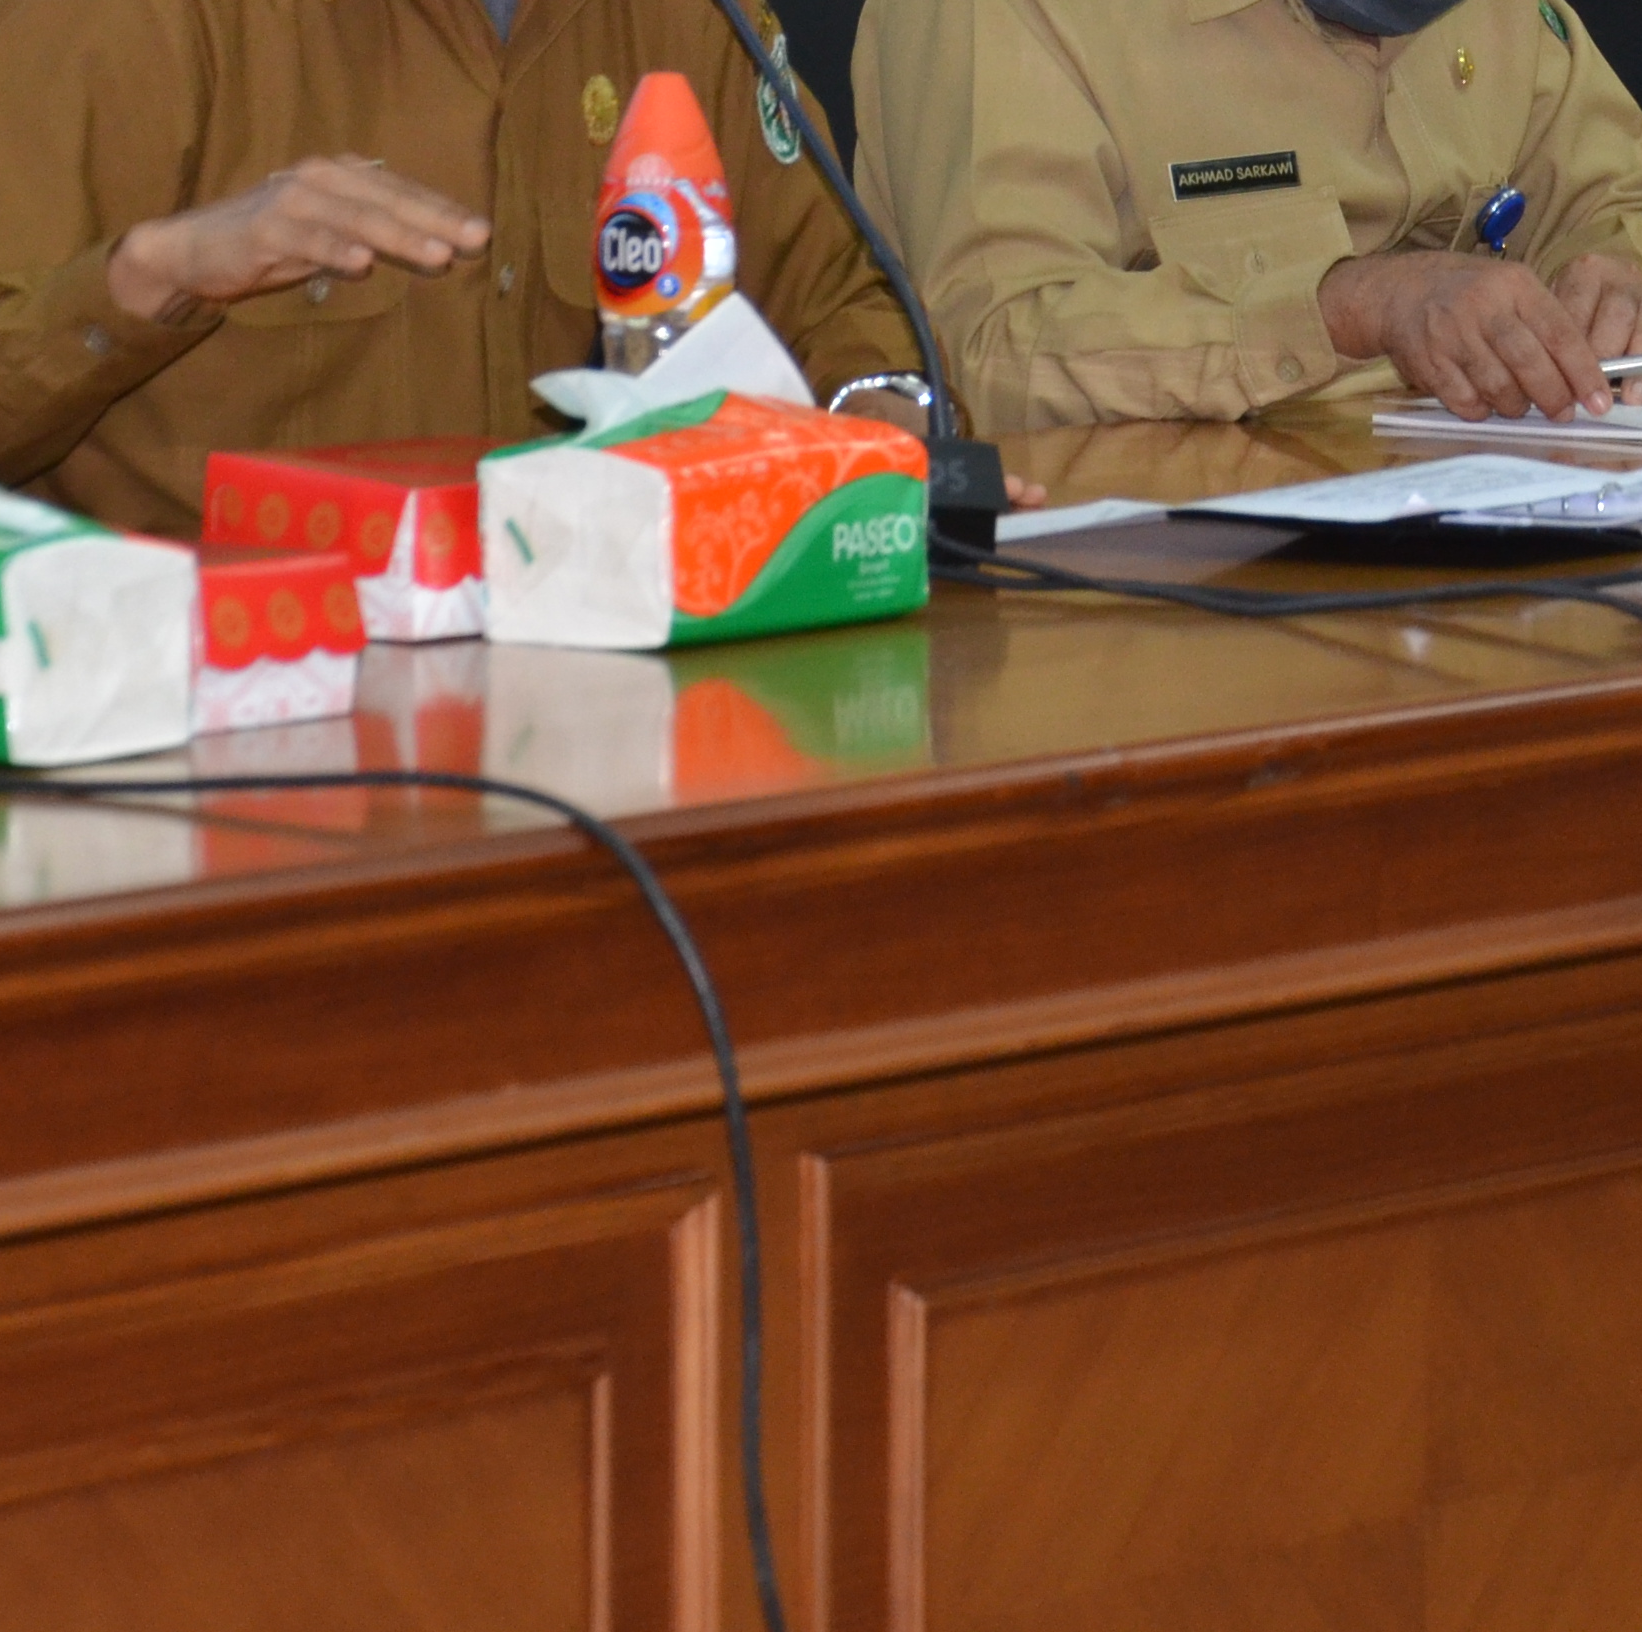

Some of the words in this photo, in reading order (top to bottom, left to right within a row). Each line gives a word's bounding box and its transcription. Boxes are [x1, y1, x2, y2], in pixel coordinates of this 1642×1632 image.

[1178, 168, 1234, 187] AKHMAD
[1236, 161, 1294, 181] SARKAWI
[602, 226, 664, 274] Cleo
[832, 513, 918, 563] PASEO
